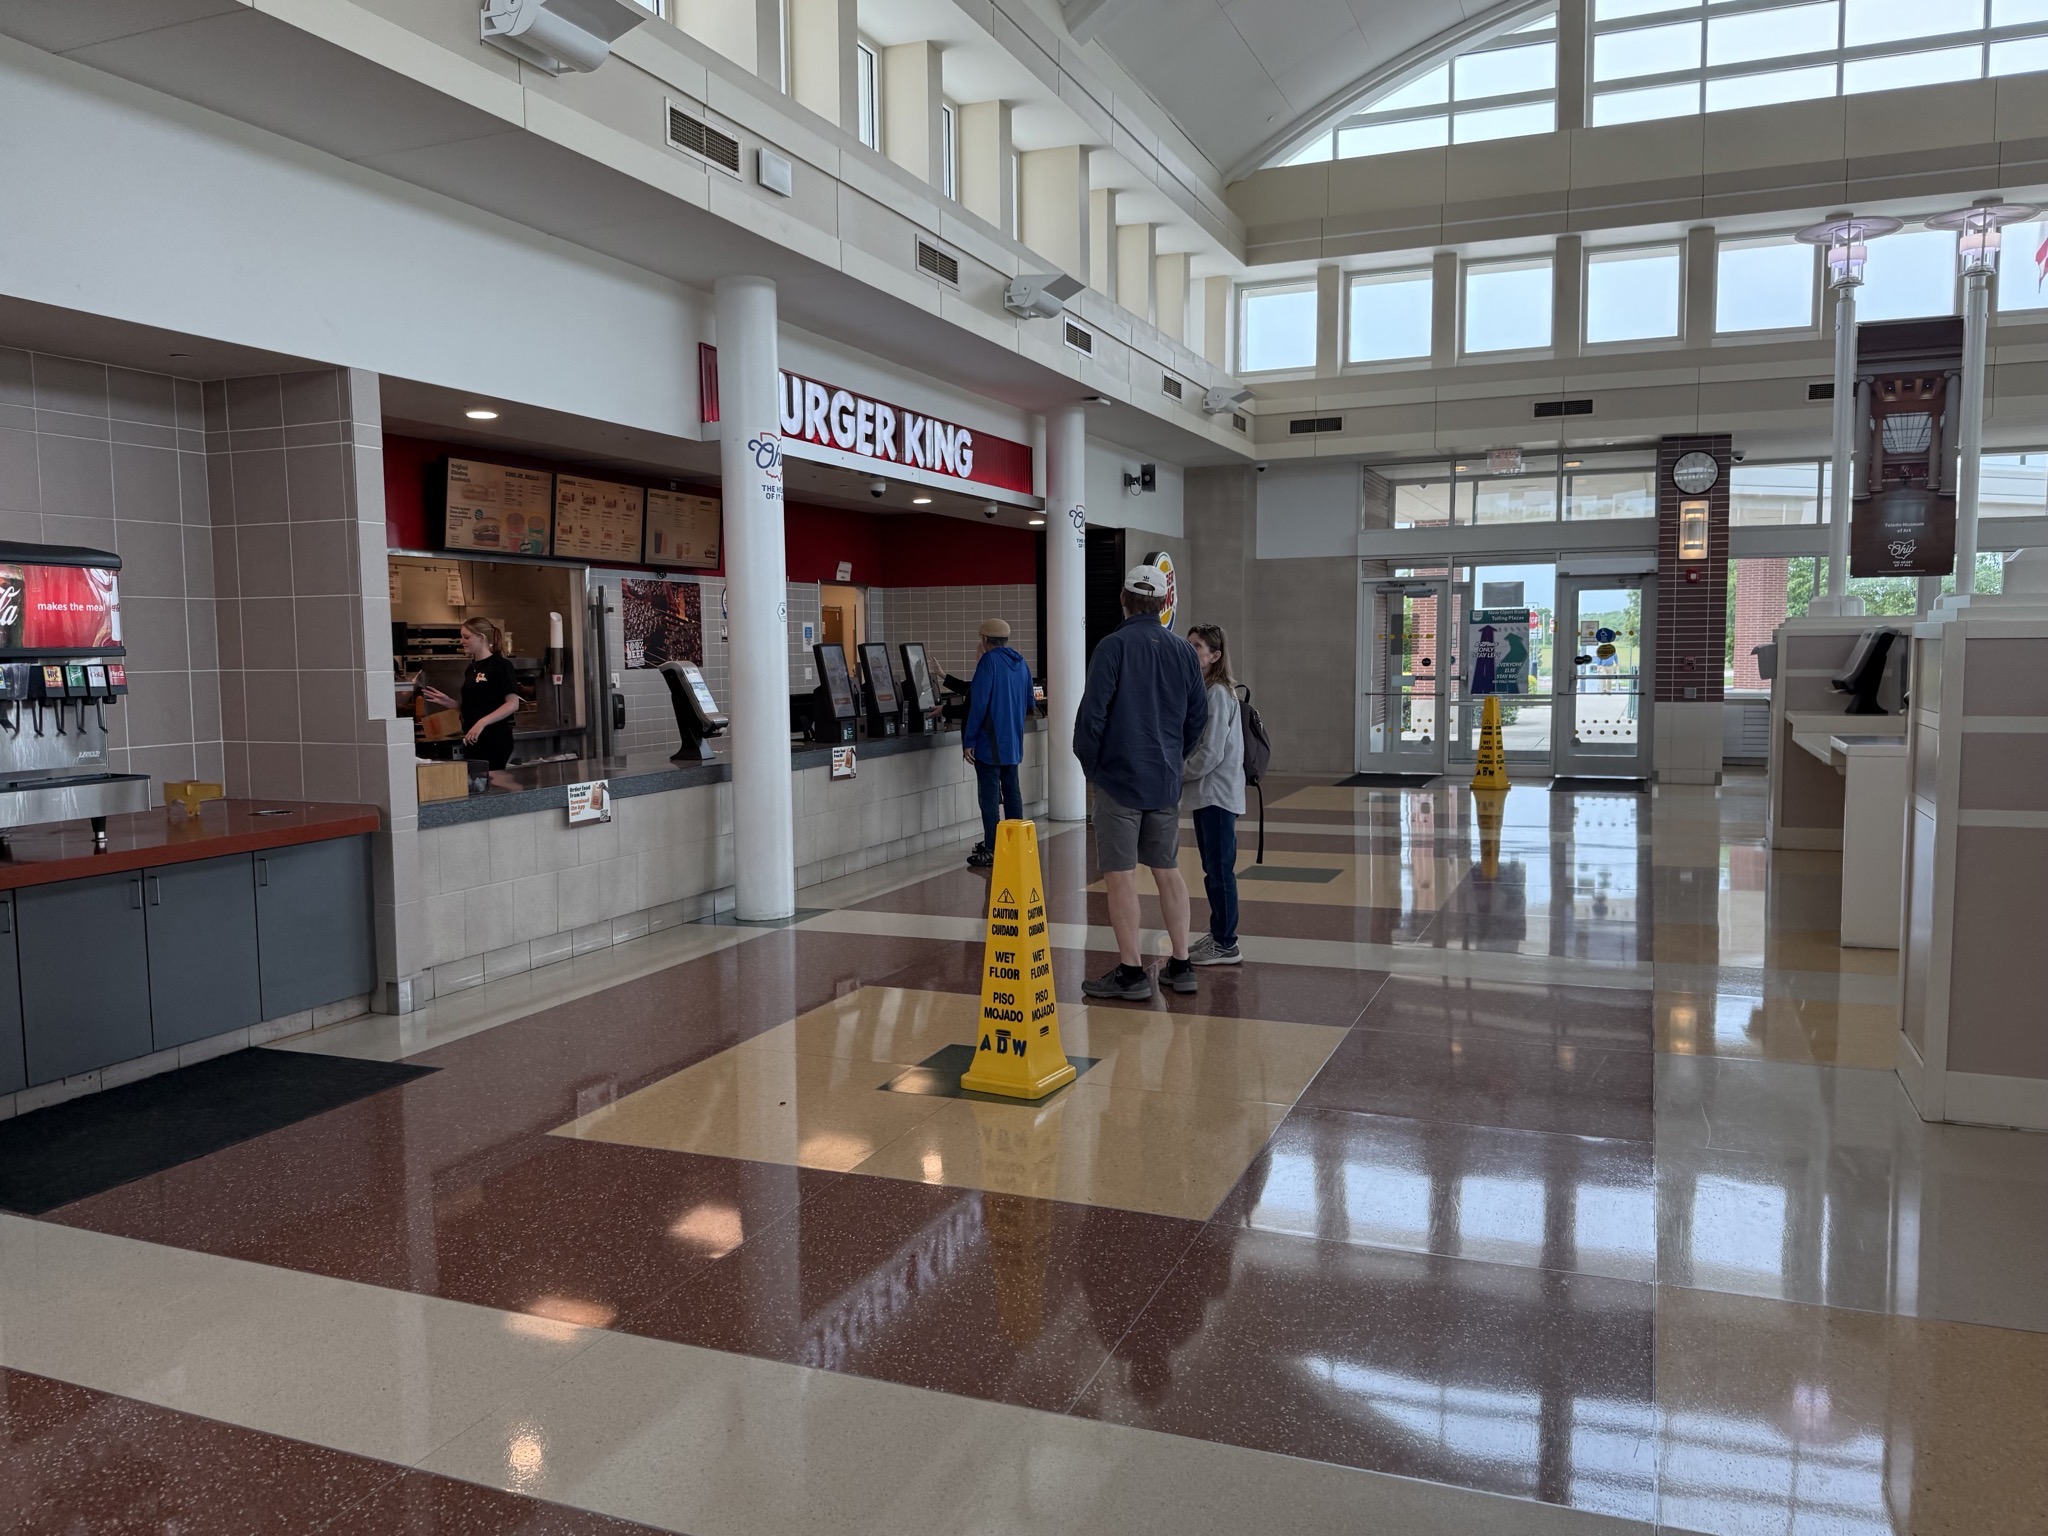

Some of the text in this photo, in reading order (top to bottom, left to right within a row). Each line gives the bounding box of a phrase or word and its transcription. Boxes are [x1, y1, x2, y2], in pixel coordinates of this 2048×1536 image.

[779, 371, 974, 478] URGER KING
[748, 439, 782, 469] Oh
[762, 484, 775, 492] THE
[765, 492, 775, 500] OF
[1888, 543, 1917, 556] Ohio
[37, 602, 67, 611] makes
[70, 602, 84, 611] the
[86, 603, 106, 612] meal
[627, 650, 644, 659] BEEF
[992, 907, 1018, 920] CAUTION
[1027, 905, 1043, 920] CAUTION
[992, 923, 1018, 937] CUIDADO
[1028, 921, 1045, 937] CUIDADO
[995, 951, 1015, 964] WET
[1032, 948, 1045, 963] WET
[989, 966, 1020, 980] FLOOR
[1030, 963, 1049, 980] FLOOR
[993, 991, 1015, 1005] PISO
[1035, 988, 1048, 1005] PISO
[984, 1006, 1024, 1023] MOJADO
[1031, 1002, 1055, 1023] MOJADO
